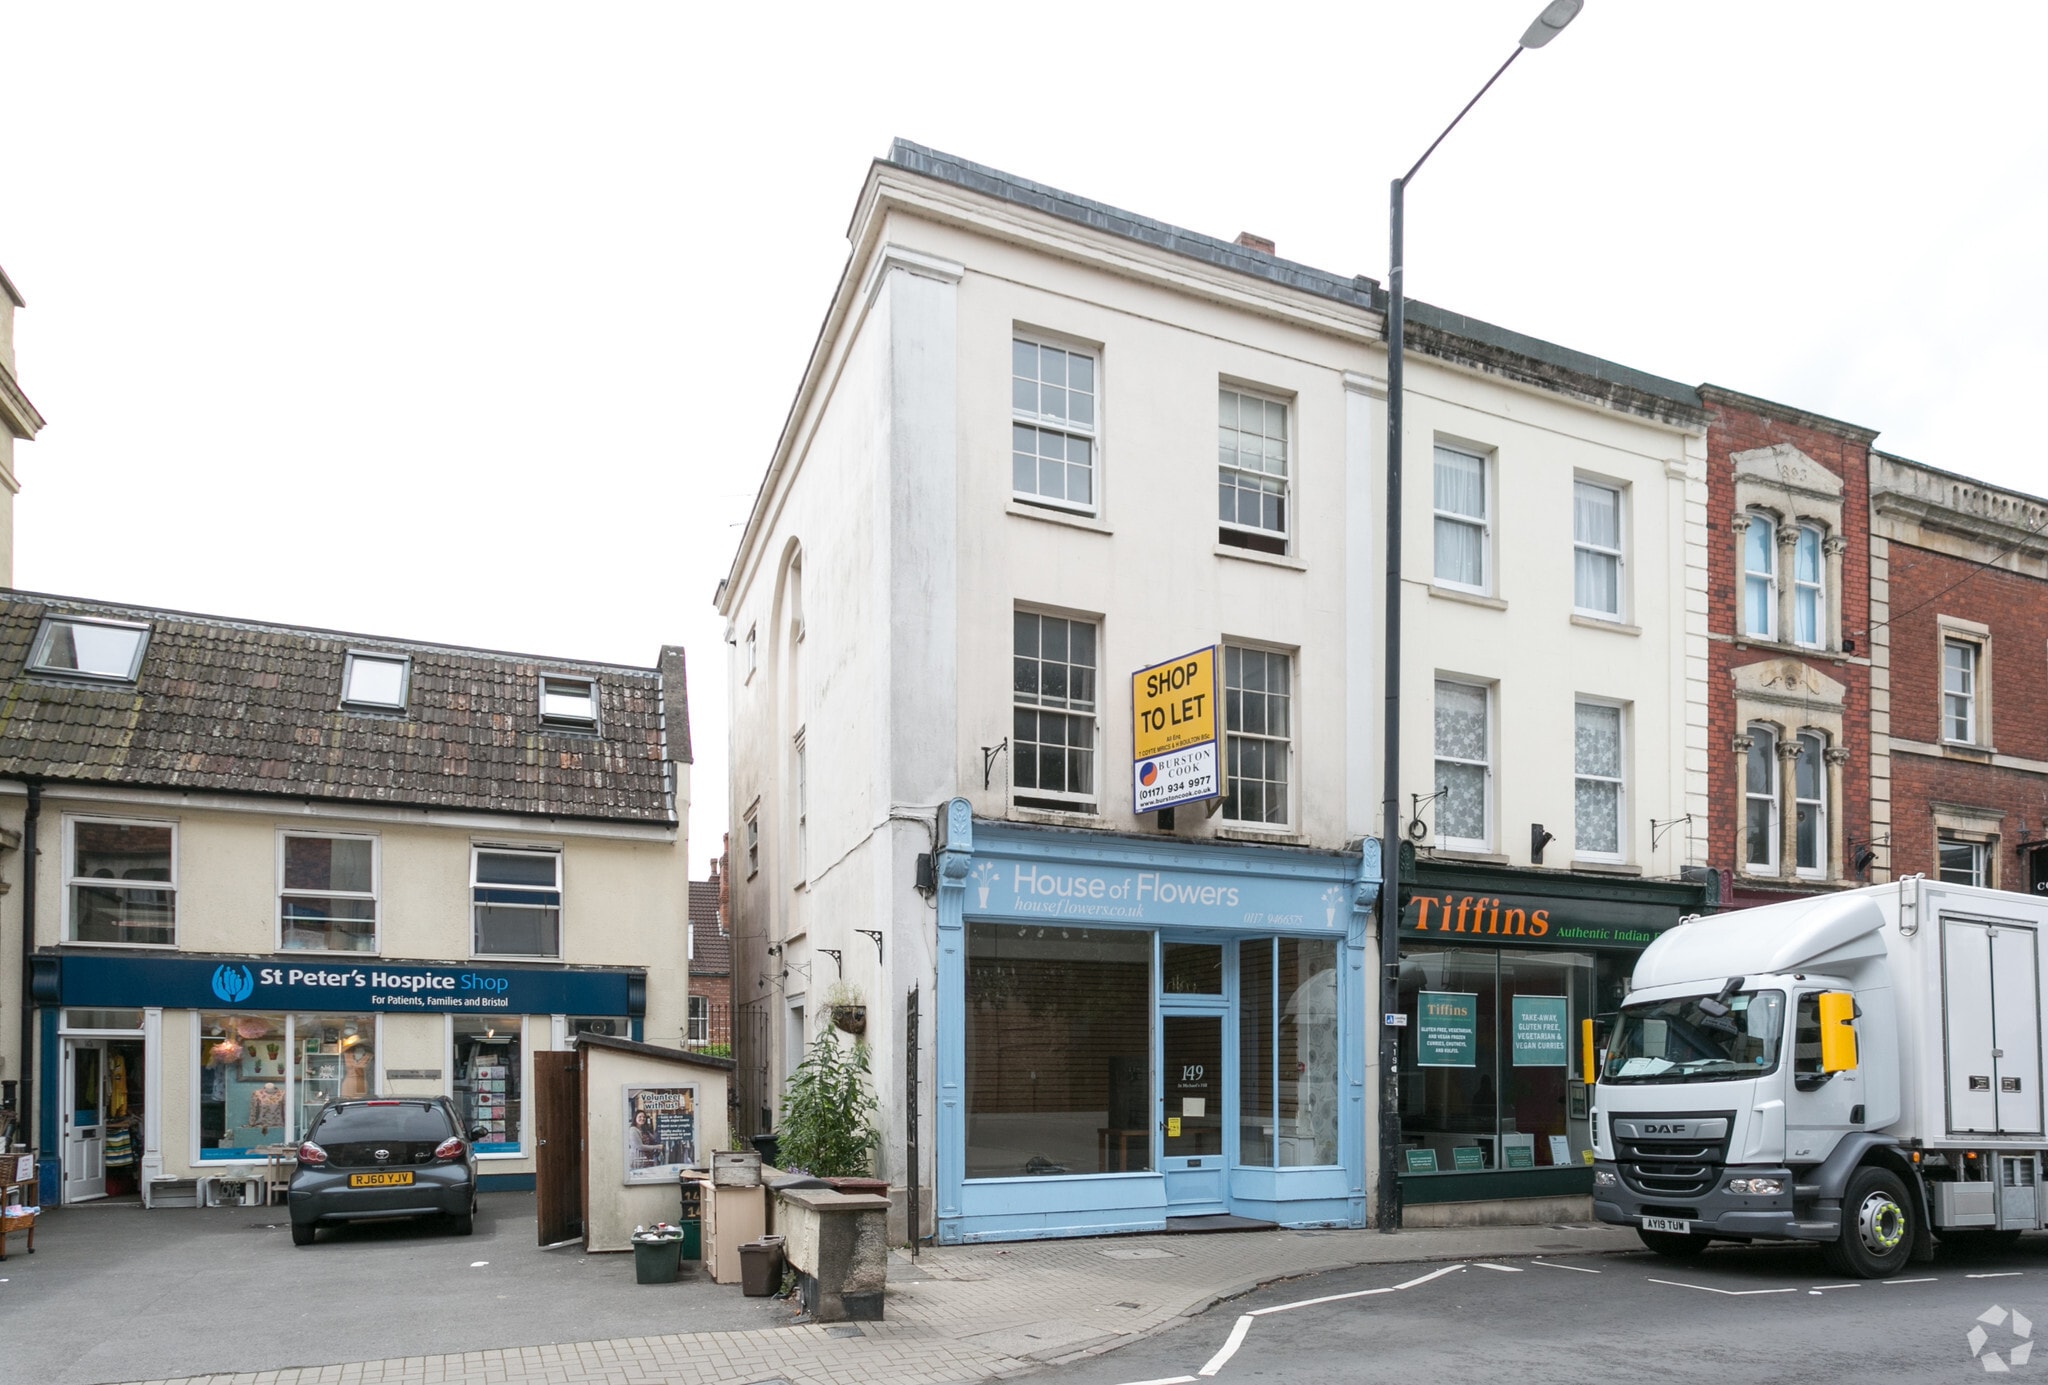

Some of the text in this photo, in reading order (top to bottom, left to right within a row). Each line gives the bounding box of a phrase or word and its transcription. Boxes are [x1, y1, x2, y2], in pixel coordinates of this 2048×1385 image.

[1147, 662, 1198, 698] SHOP
[1141, 694, 1205, 733] TO LET
[1158, 749, 1211, 771] BURSTON
[1168, 763, 1200, 778] COOK
[1140, 775, 1211, 800] (0117) 934 9977
[1140, 787, 1211, 808] www.burstoncook.co.uk
[1014, 864, 1240, 907] House of Flowers
[1014, 896, 1143, 917] houseflowers.co.uk
[1410, 894, 1550, 937] Tiffins
[1556, 926, 1610, 939] Authentic
[1614, 930, 1650, 941] Indian
[260, 969, 508, 994] St Peter's Hospice Shop
[372, 996, 508, 1008] For Patients, Families and Bristol
[1427, 1004, 1468, 1016] Tiffins
[1522, 1013, 1558, 1022] TAKE-AWAY,
[1543, 1024, 1560, 1032] FREE,
[1538, 1042, 1564, 1050] CURRIES
[1182, 1065, 1204, 1081] 149
[1644, 1124, 1685, 1133] DAF
[356, 1173, 408, 1184] RJ60 YJV
[1648, 1220, 1666, 1229] AY19
